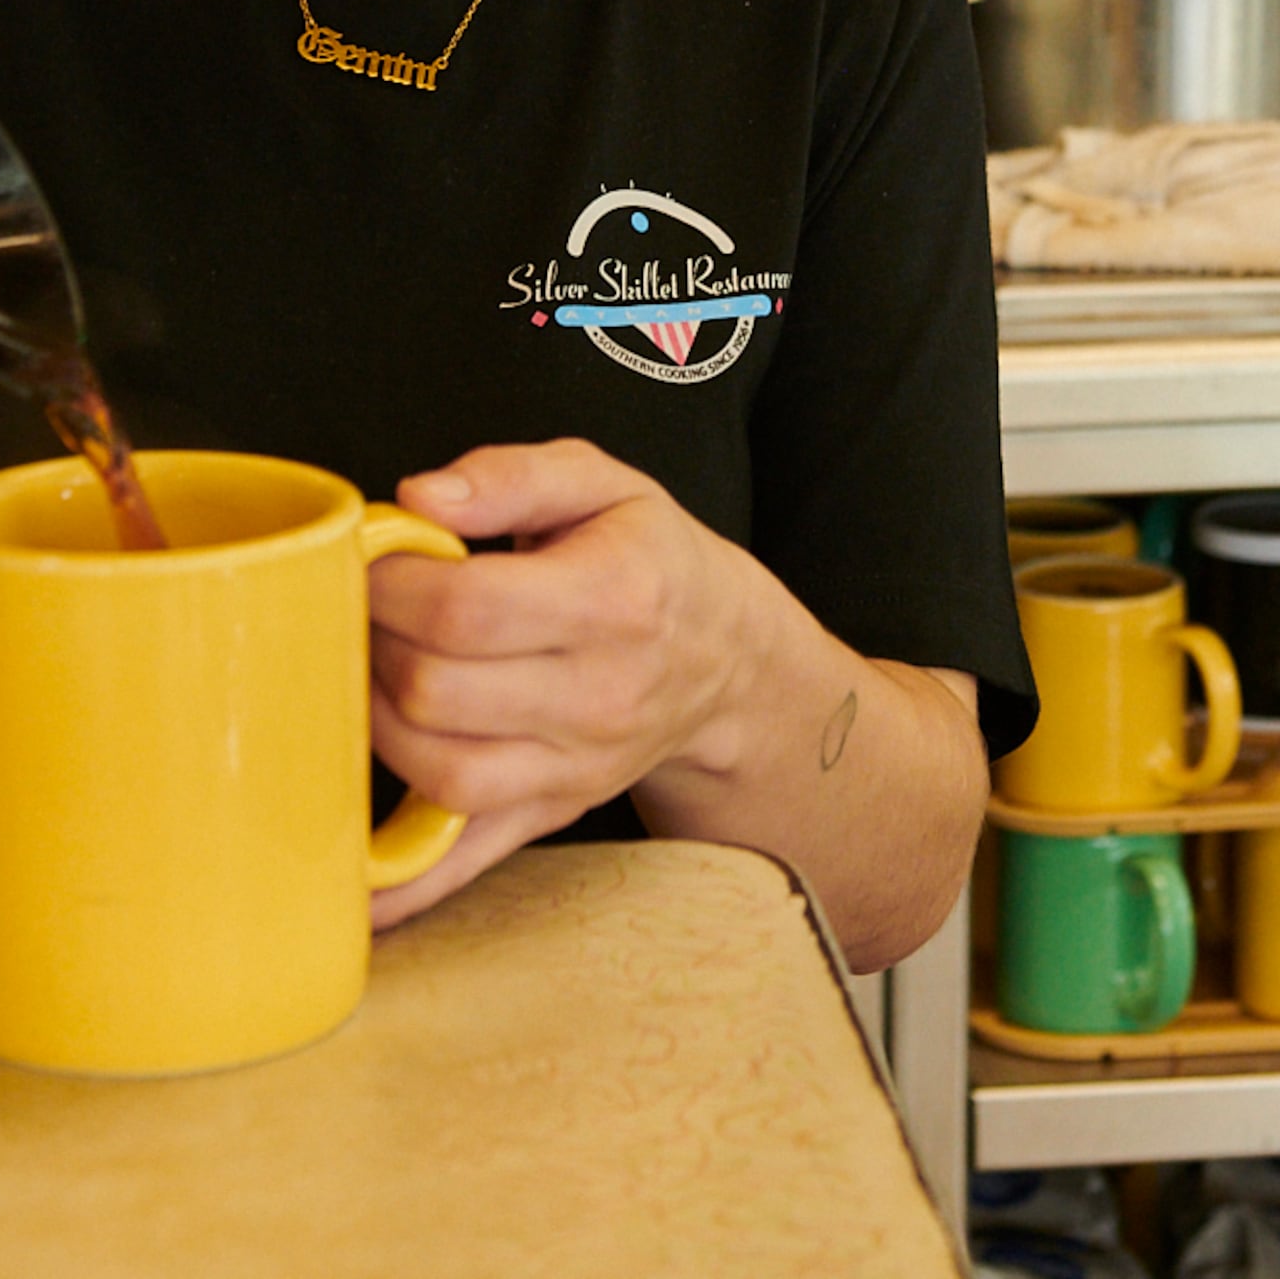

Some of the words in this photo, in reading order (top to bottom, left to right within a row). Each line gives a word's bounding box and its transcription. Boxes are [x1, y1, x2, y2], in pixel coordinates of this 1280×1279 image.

[297, 27, 437, 91] Gemini
[499, 259, 589, 309] Silver
[593, 257, 679, 302] Skillet
[565, 300, 764, 320] ATLANTA
[597, 335, 656, 373] SOUTHERN
[658, 365, 709, 380] COOKING
[708, 350, 734, 373] SINCE
[733, 326, 750, 351] 1956
